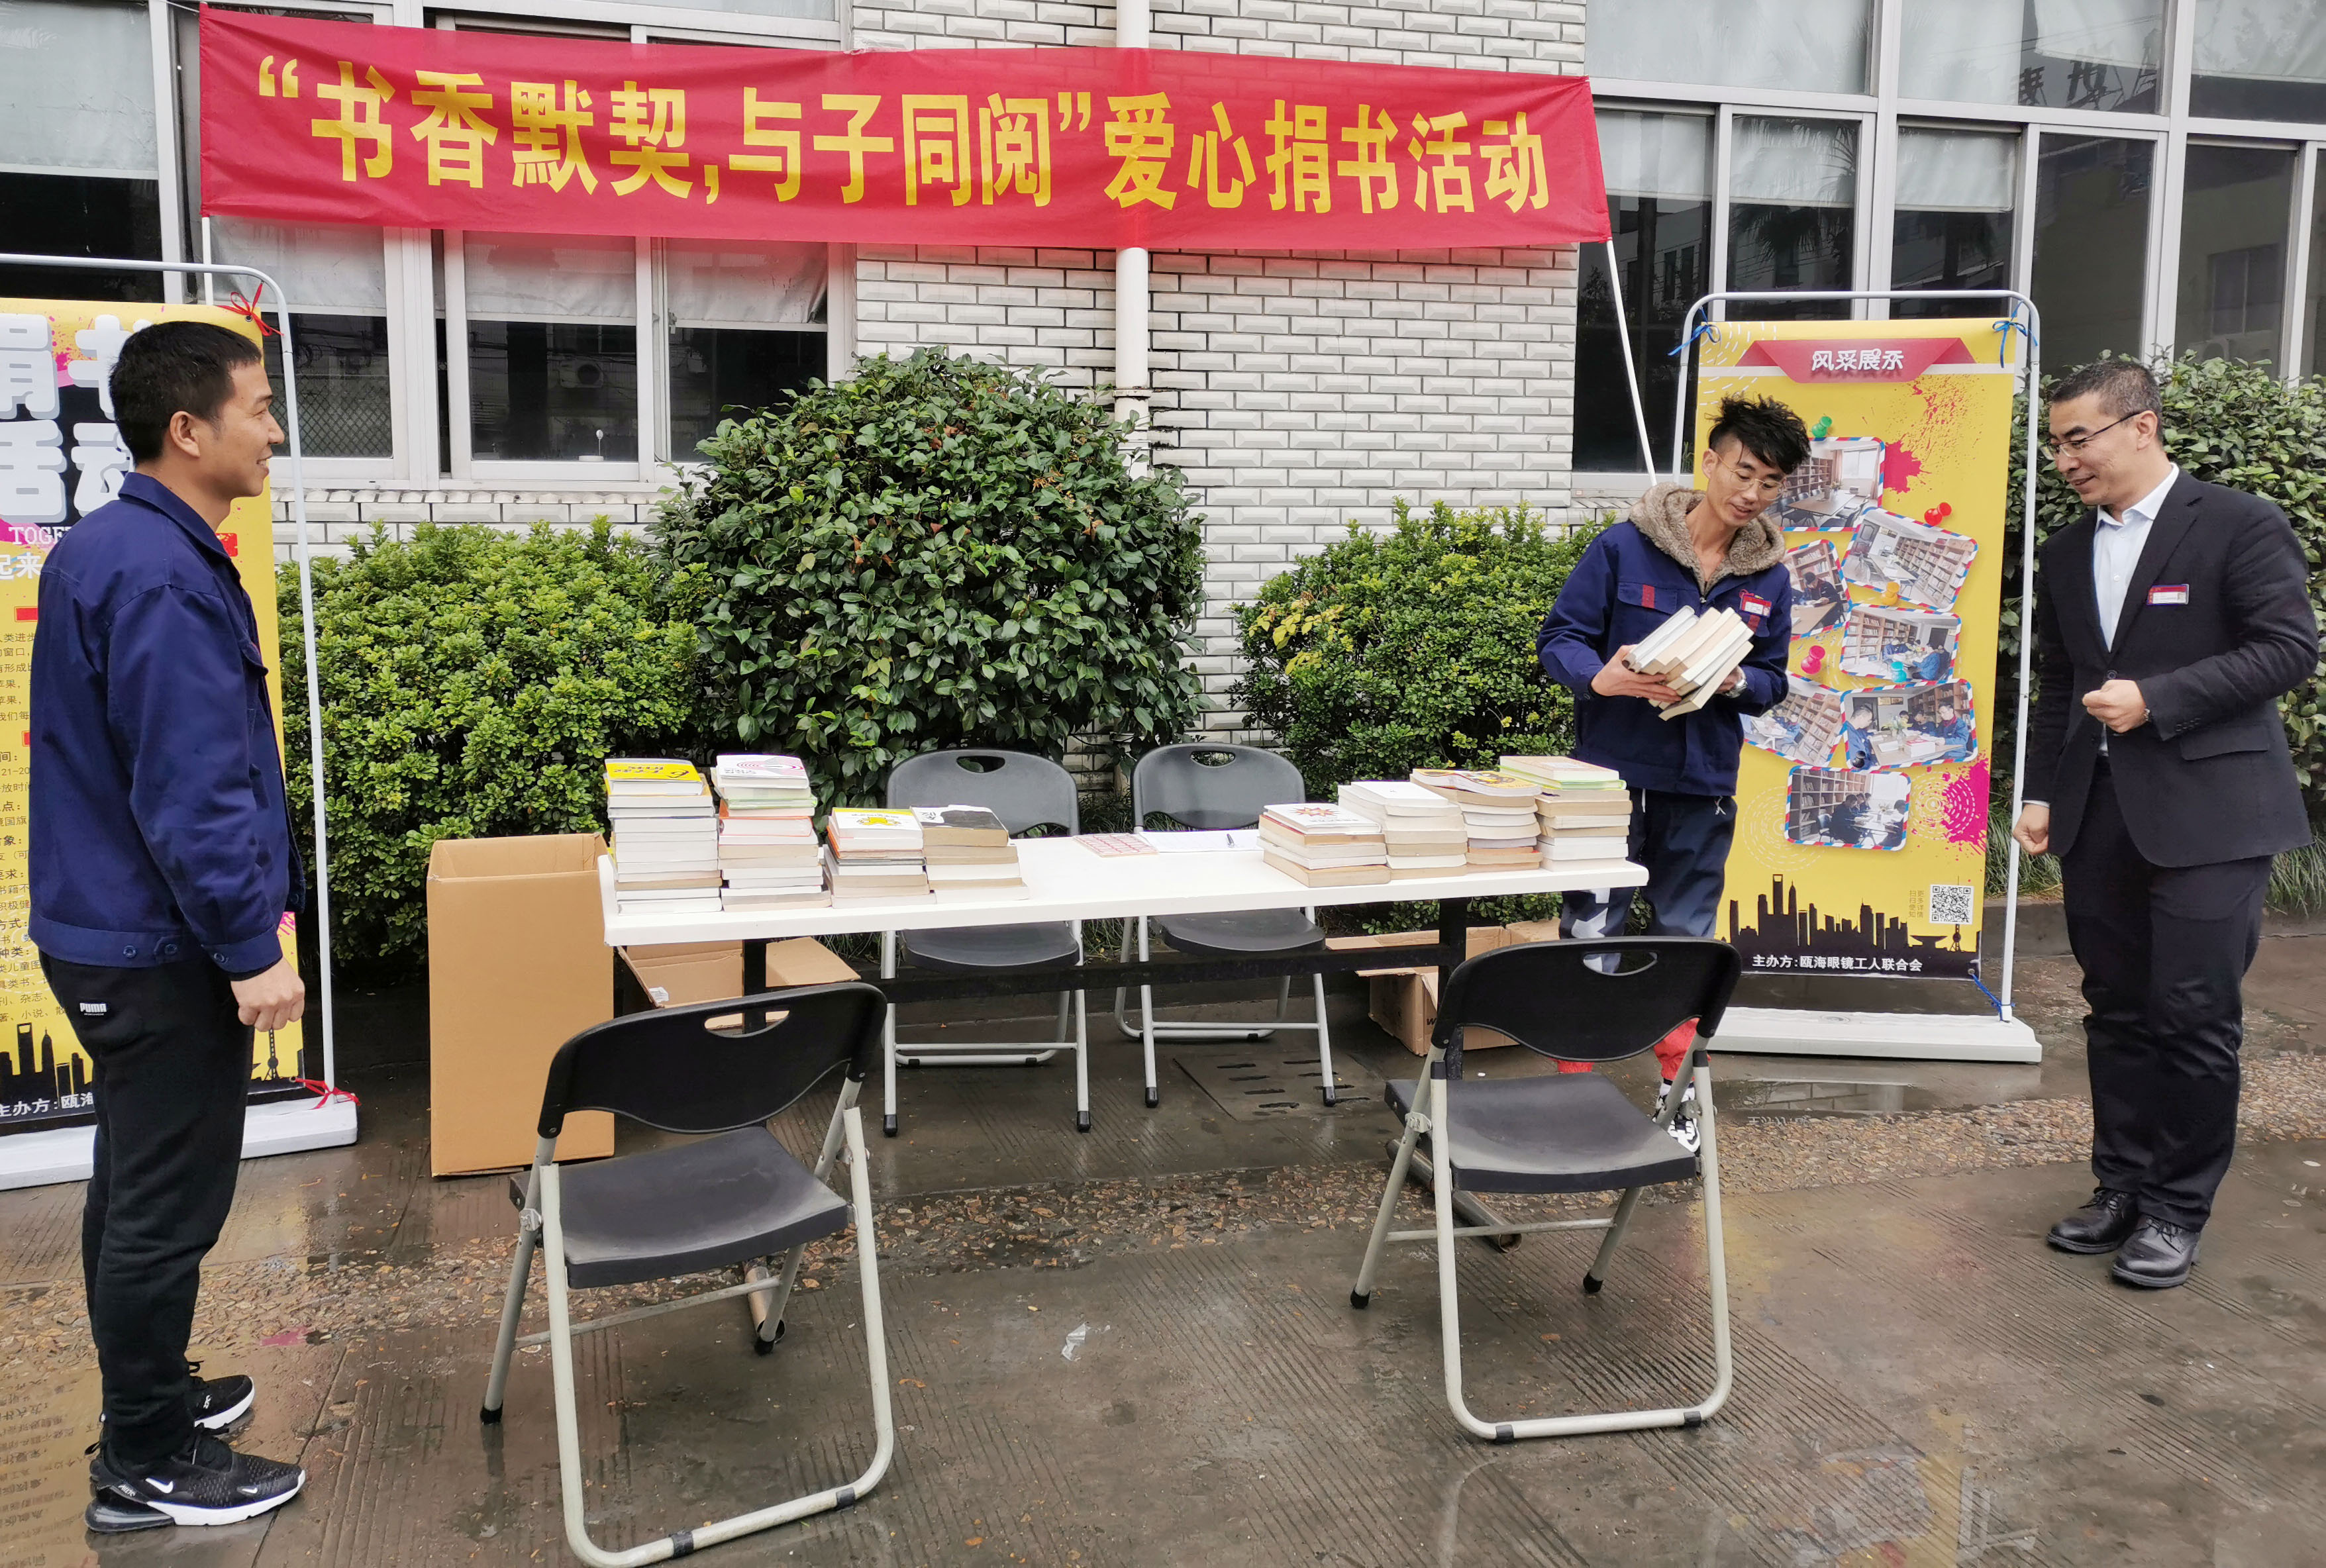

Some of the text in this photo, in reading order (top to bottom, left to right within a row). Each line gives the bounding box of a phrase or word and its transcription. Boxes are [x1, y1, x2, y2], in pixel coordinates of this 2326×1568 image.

[1811, 348, 1904, 371] 风采展示
[9, 526, 72, 544] TOGE
[0, 633, 35, 643] 类进步
[0, 648, 30, 657] 窗口，
[0, 801, 21, 812] 点：
[0, 836, 21, 846] 象：
[1752, 955, 1923, 971] 主办方:瓯海眼镜工人联合会
[79, 1003, 107, 1012] PUMA
